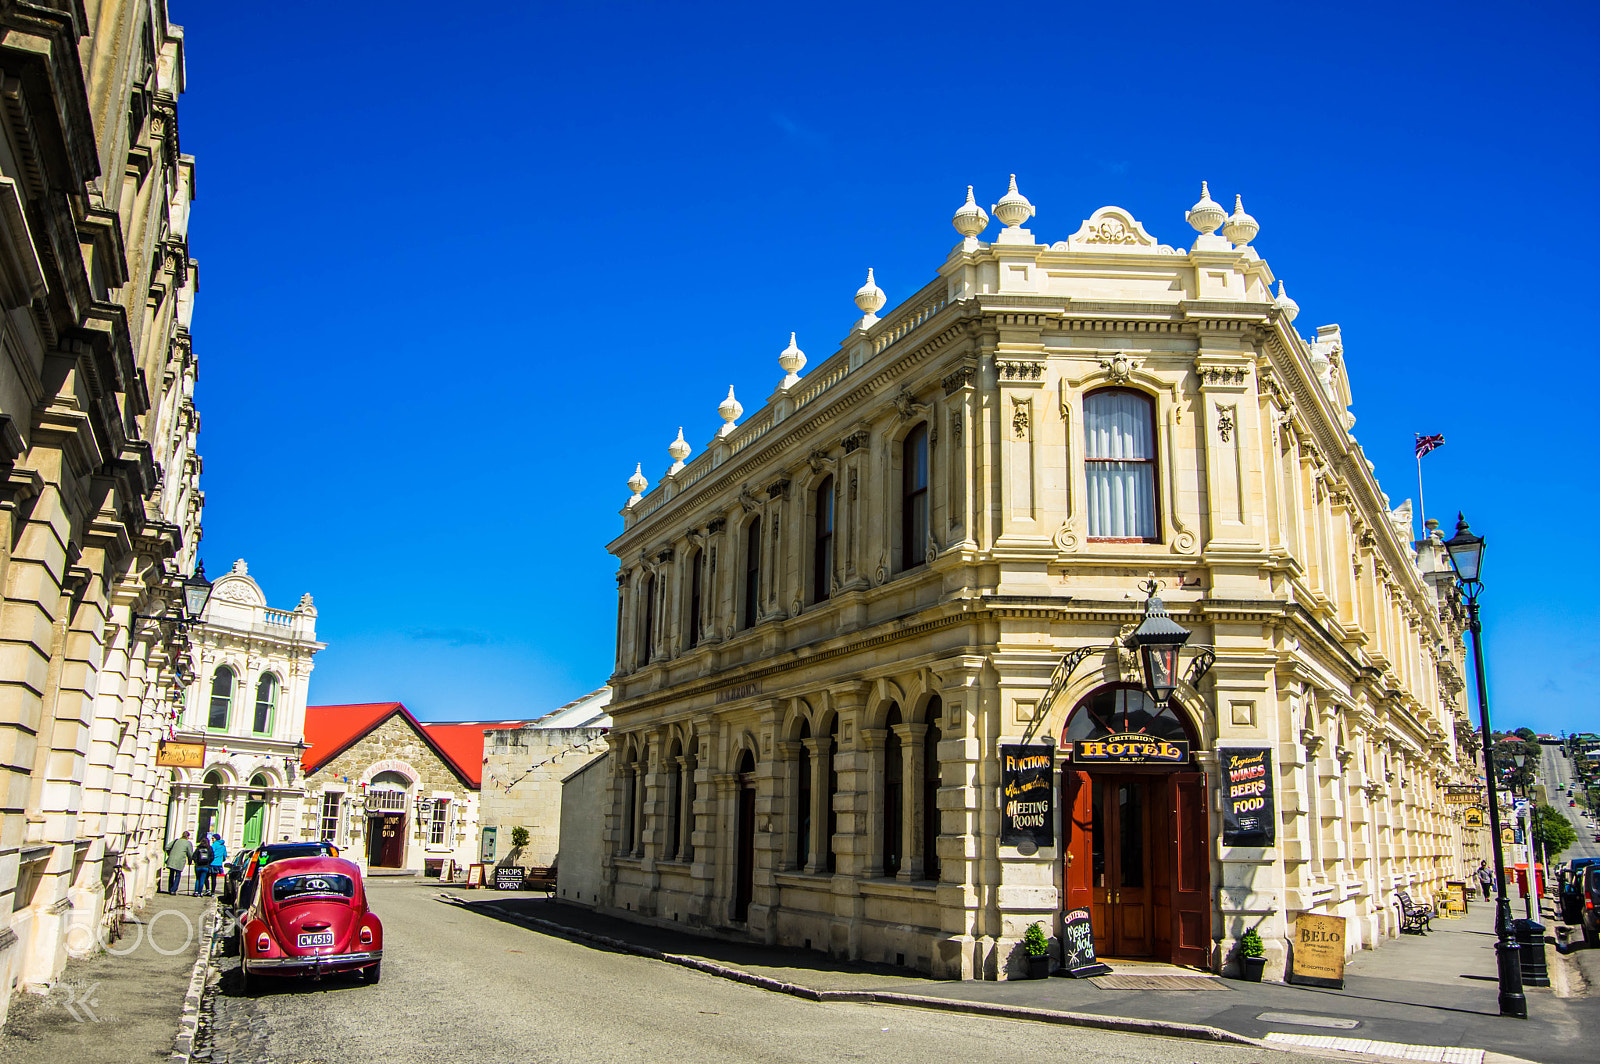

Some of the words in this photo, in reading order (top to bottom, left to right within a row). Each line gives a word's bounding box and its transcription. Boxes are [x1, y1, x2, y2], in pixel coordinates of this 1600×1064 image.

[1108, 735, 1155, 743] CRITERION
[1080, 742, 1183, 761] HOTEL
[1229, 751, 1265, 769] Regional
[1006, 755, 1051, 773] FUNCTIONS
[1229, 764, 1266, 782] WINES
[1230, 780, 1267, 798] BEERS
[1006, 800, 1049, 817] MEETING
[1233, 797, 1265, 815] FOOD
[1012, 813, 1045, 830] ROOMS
[498, 868, 522, 876] SHOPS
[499, 882, 520, 890] OPEN
[300, 935, 313, 945] CW
[313, 934, 332, 945] 4519
[1300, 928, 1341, 943] BELO
